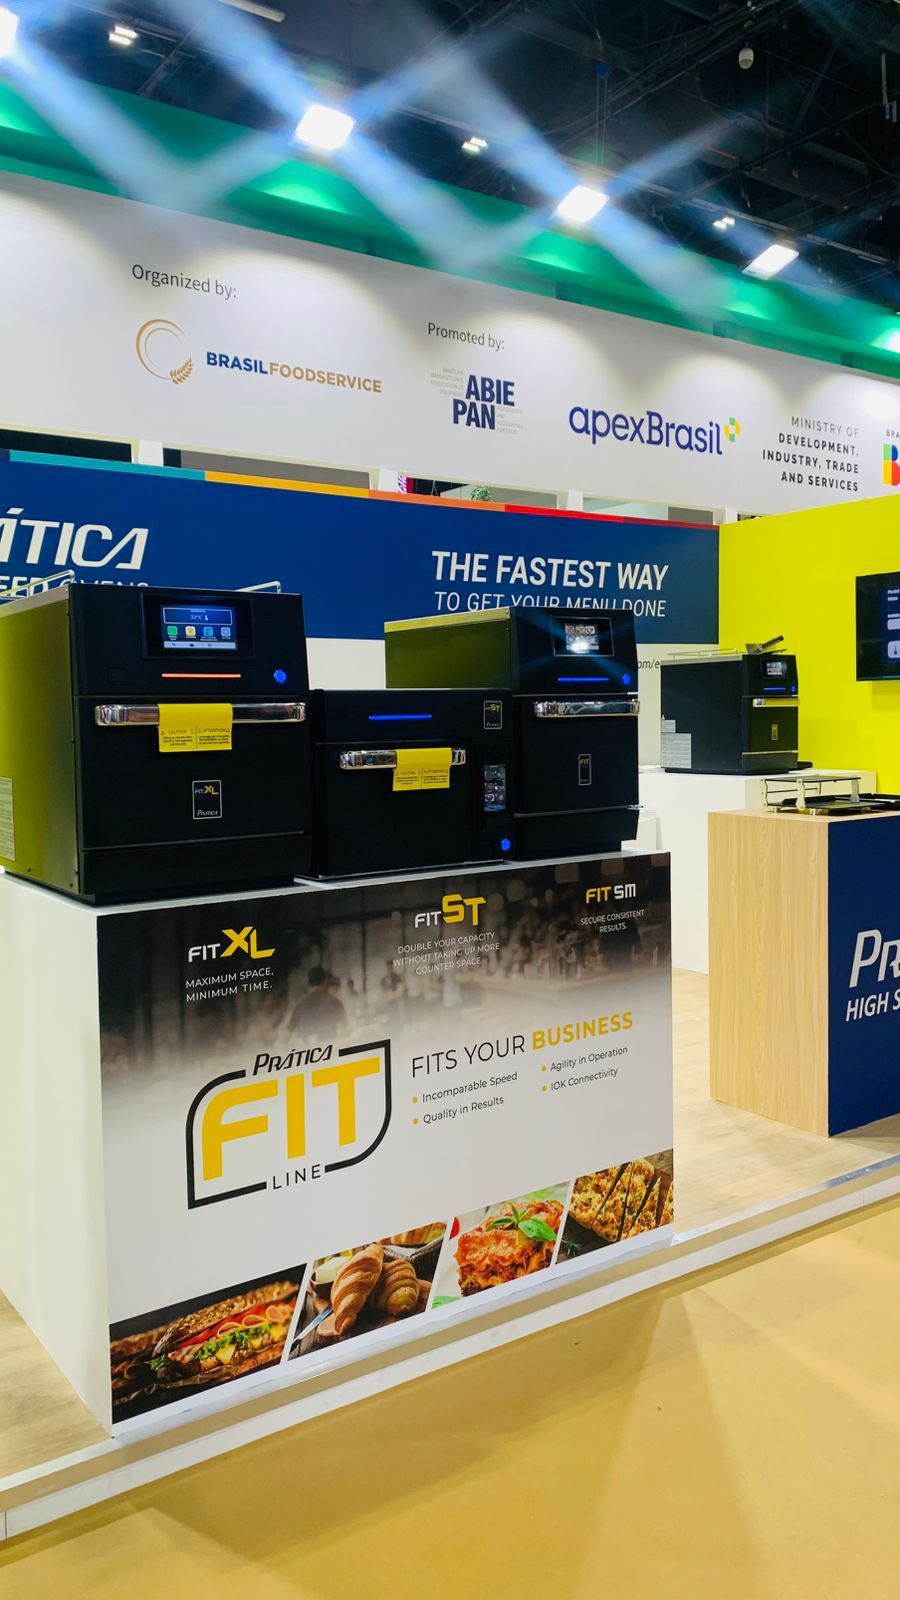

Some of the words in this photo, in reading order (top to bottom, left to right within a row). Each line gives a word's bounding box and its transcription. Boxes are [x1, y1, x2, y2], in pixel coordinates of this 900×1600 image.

[132, 264, 210, 294] Organized
[215, 281, 237, 300] by:
[428, 322, 485, 346] Promoted
[488, 333, 505, 351] by:
[206, 351, 382, 393] BRASILFOODSERVICE
[465, 374, 515, 407] ABIE
[452, 398, 495, 430] PAN
[791, 416, 842, 436] MINISTRY
[846, 427, 859, 438] OF
[569, 406, 723, 455] apexBrasil
[778, 432, 859, 457] DEVELOPMENT,
[762, 449, 821, 469] INDUSTRY,
[826, 459, 858, 474] TRADE
[781, 471, 804, 484] AND
[808, 475, 858, 491] SERVICES
[432, 551, 489, 582] THE
[496, 555, 611, 589] FASTEST
[617, 562, 669, 591] WAY
[435, 592, 460, 611] TO
[467, 593, 505, 611] GET
[511, 595, 560, 608] YOUR
[566, 597, 615, 610] MENU
[621, 599, 667, 617] DONE
[585, 886, 612, 904] FIT
[614, 883, 637, 900] SM
[580, 915, 605, 925] SECURE
[606, 909, 645, 922] CONSISTENT
[392, 954, 432, 967] WITHOUT
[434, 949, 463, 961] TAKING
[464, 946, 475, 955] UP
[477, 943, 500, 953] MORE
[397, 941, 432, 954] DOUBLE
[434, 937, 456, 948] YOUR
[458, 932, 495, 945] CAPACITY
[416, 962, 455, 975] COUNTER
[456, 957, 481, 968] SPACE
[185, 973, 237, 989] MAXIMUM
[186, 986, 238, 1002] MINIMUM
[242, 980, 273, 993] TIME.
[845, 992, 889, 1022] HIGH
[412, 1049, 458, 1078] FITS
[464, 1034, 525, 1065] YOUR
[532, 1011, 633, 1050] BUSINESS
[550, 1057, 577, 1073] Agility
[579, 1055, 586, 1065] in
[588, 1045, 628, 1063] Operation
[422, 1078, 487, 1103] Incomparable
[490, 1071, 518, 1088] Speed
[568, 1067, 618, 1087] Connectivity
[202, 1056, 380, 1181] FIT
[423, 1107, 458, 1125] Quality
[460, 1105, 469, 1115] in
[471, 1095, 504, 1112] Results
[273, 1164, 321, 1190] LINE
